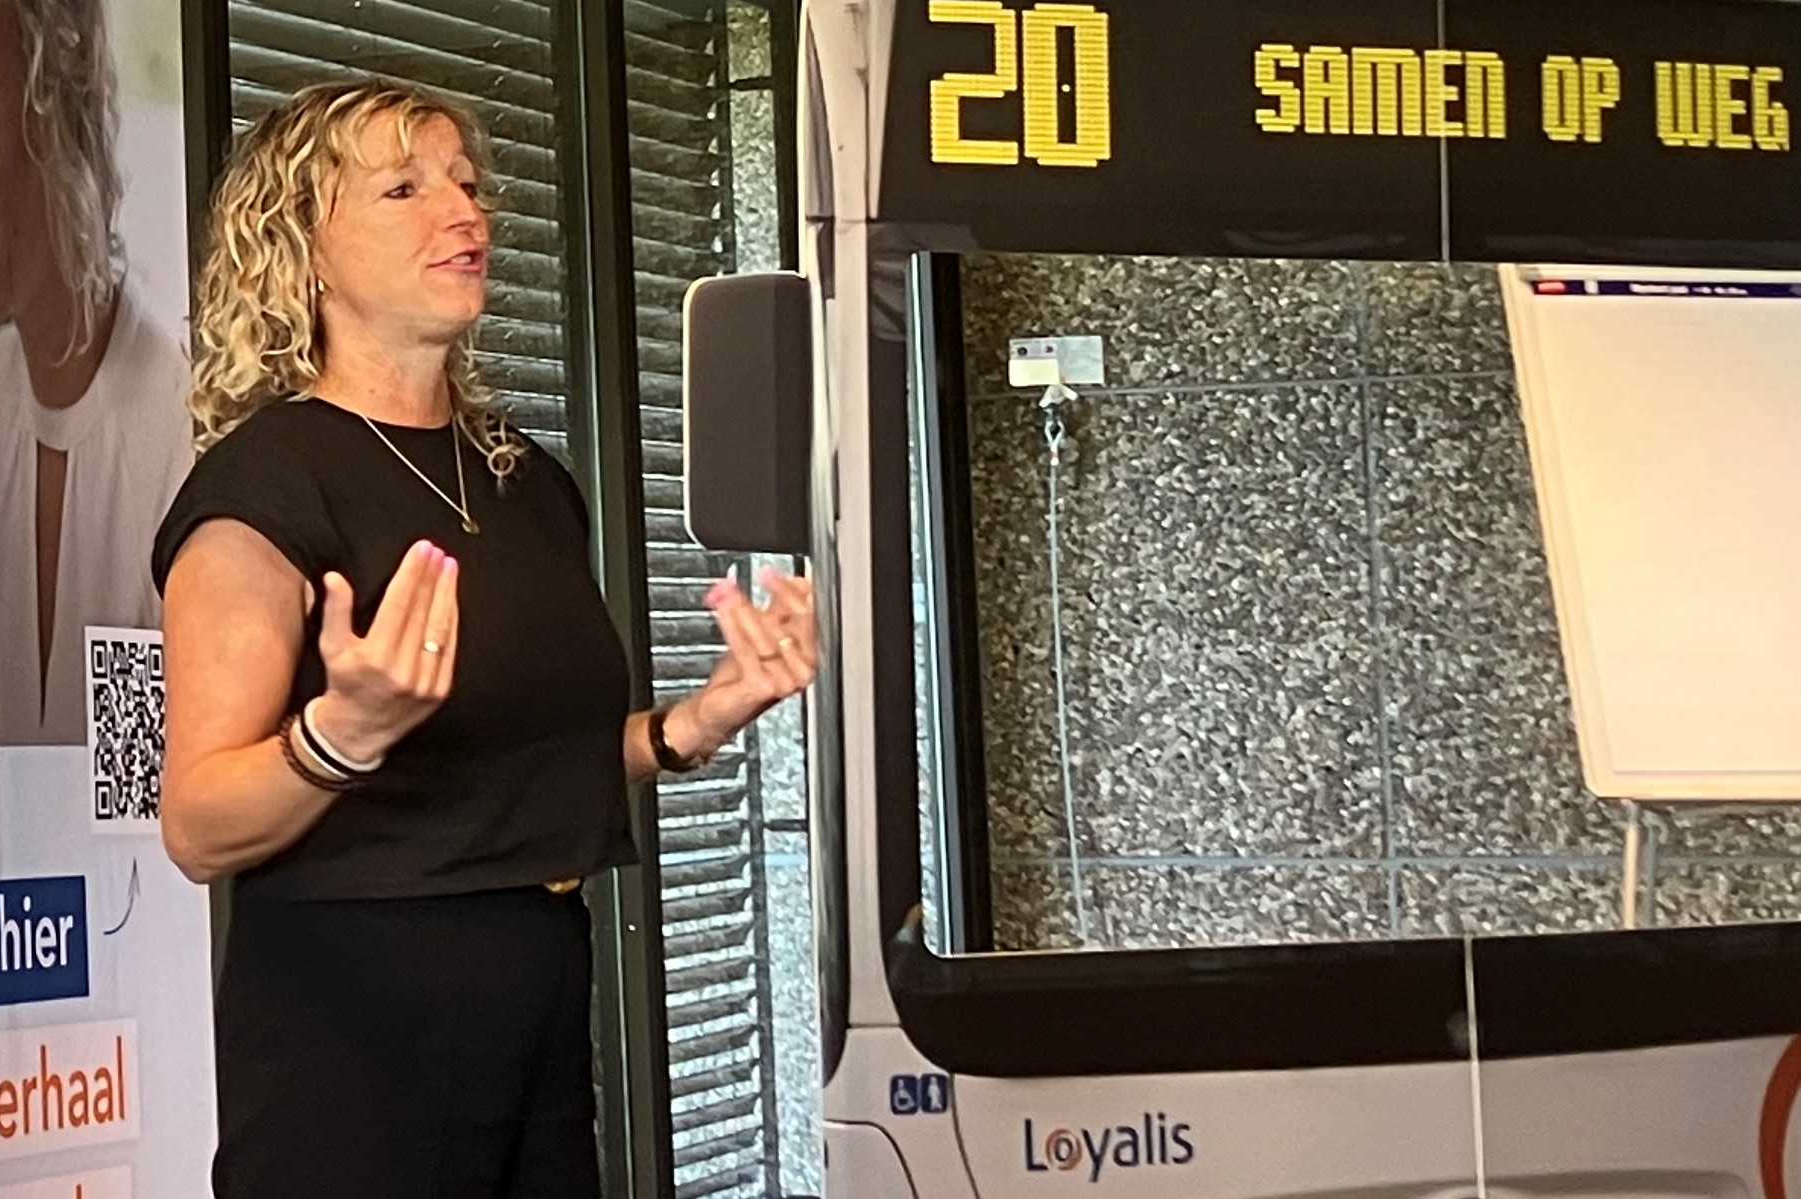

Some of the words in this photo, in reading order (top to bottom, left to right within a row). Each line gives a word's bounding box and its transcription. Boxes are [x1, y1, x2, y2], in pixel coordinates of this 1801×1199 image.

[928, 0, 1111, 168] 20
[1255, 43, 1507, 139] SAMEN
[1541, 55, 1621, 143] OP
[1654, 61, 1790, 151] WEG
[0, 893, 74, 971] hier
[1024, 1112, 1194, 1183] Loyalis
